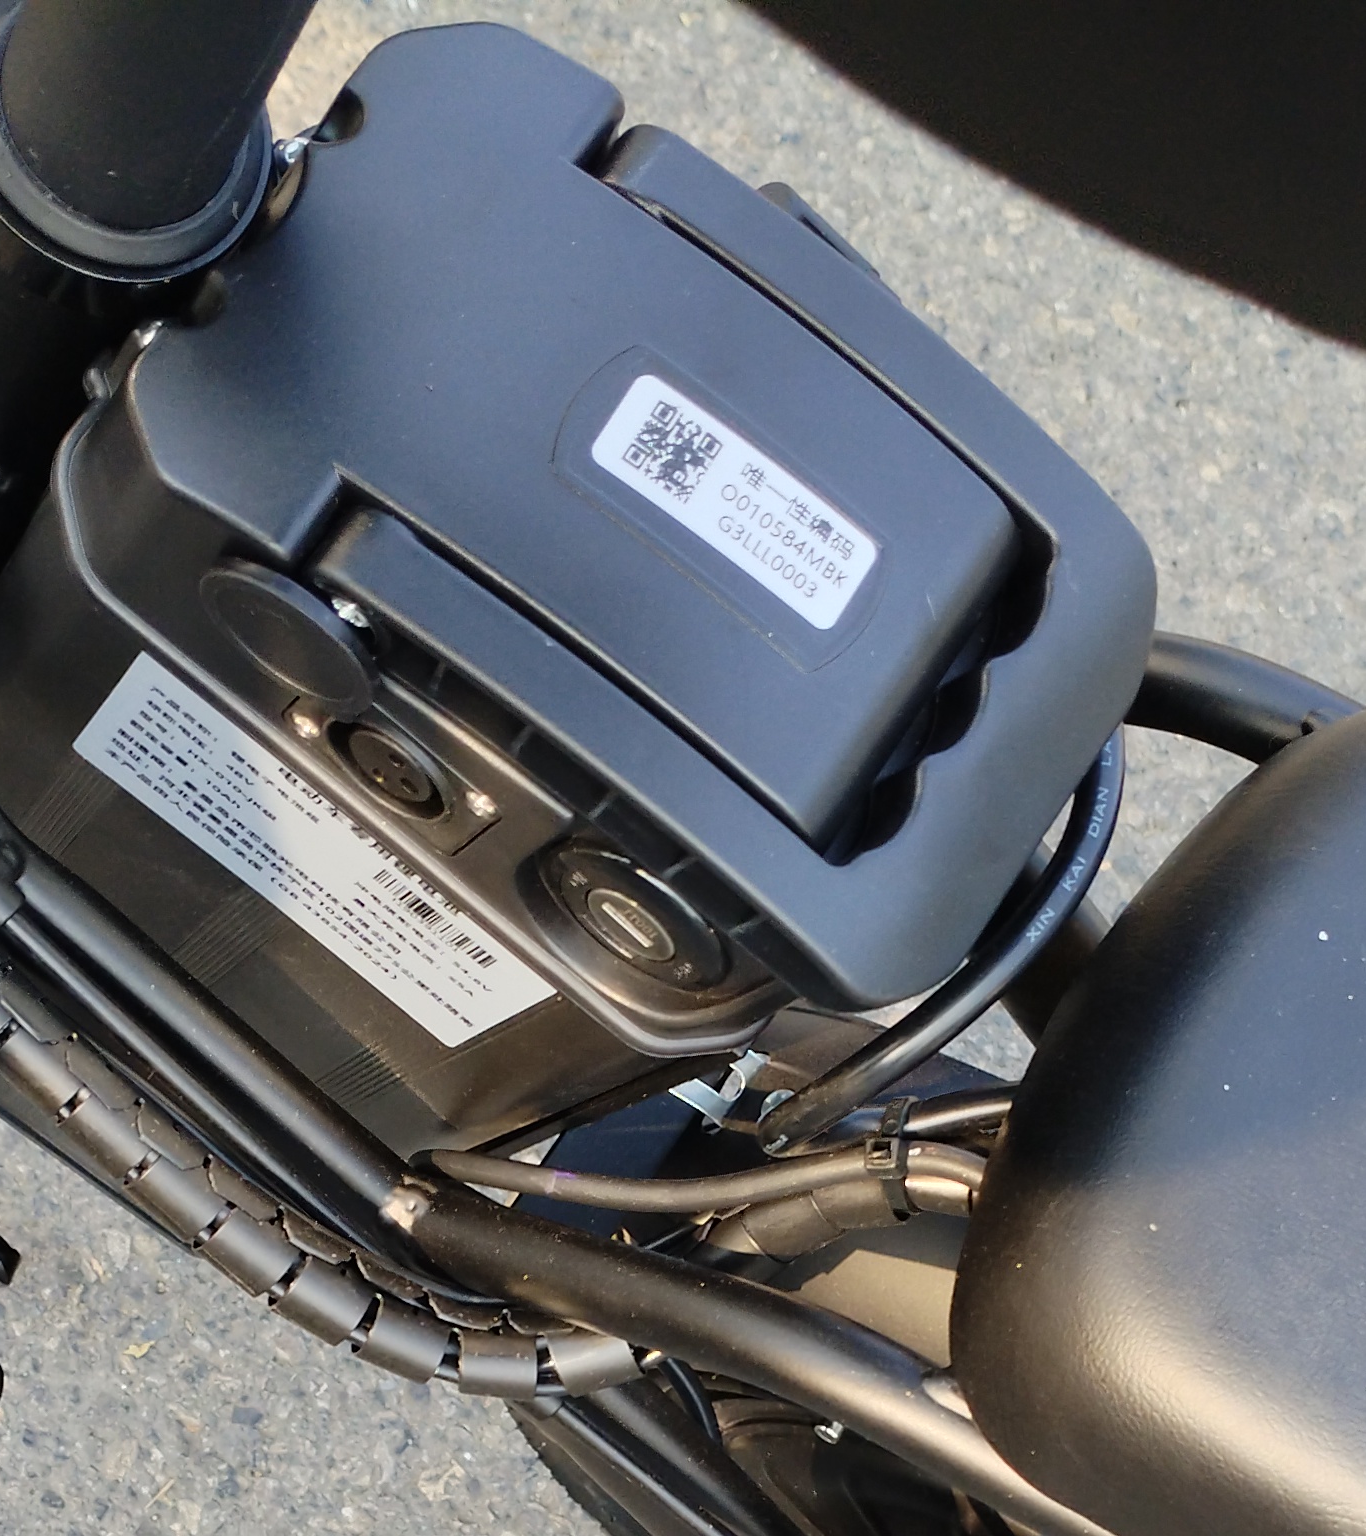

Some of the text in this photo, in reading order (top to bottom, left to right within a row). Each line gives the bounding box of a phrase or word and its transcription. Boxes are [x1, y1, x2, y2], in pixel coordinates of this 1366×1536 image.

[715, 513, 820, 599] G3LLL0003
[737, 460, 859, 561] 唯一性编码
[1025, 906, 1055, 943] XIN
[1062, 856, 1086, 892] KAI
[1088, 787, 1109, 838] DIAN
